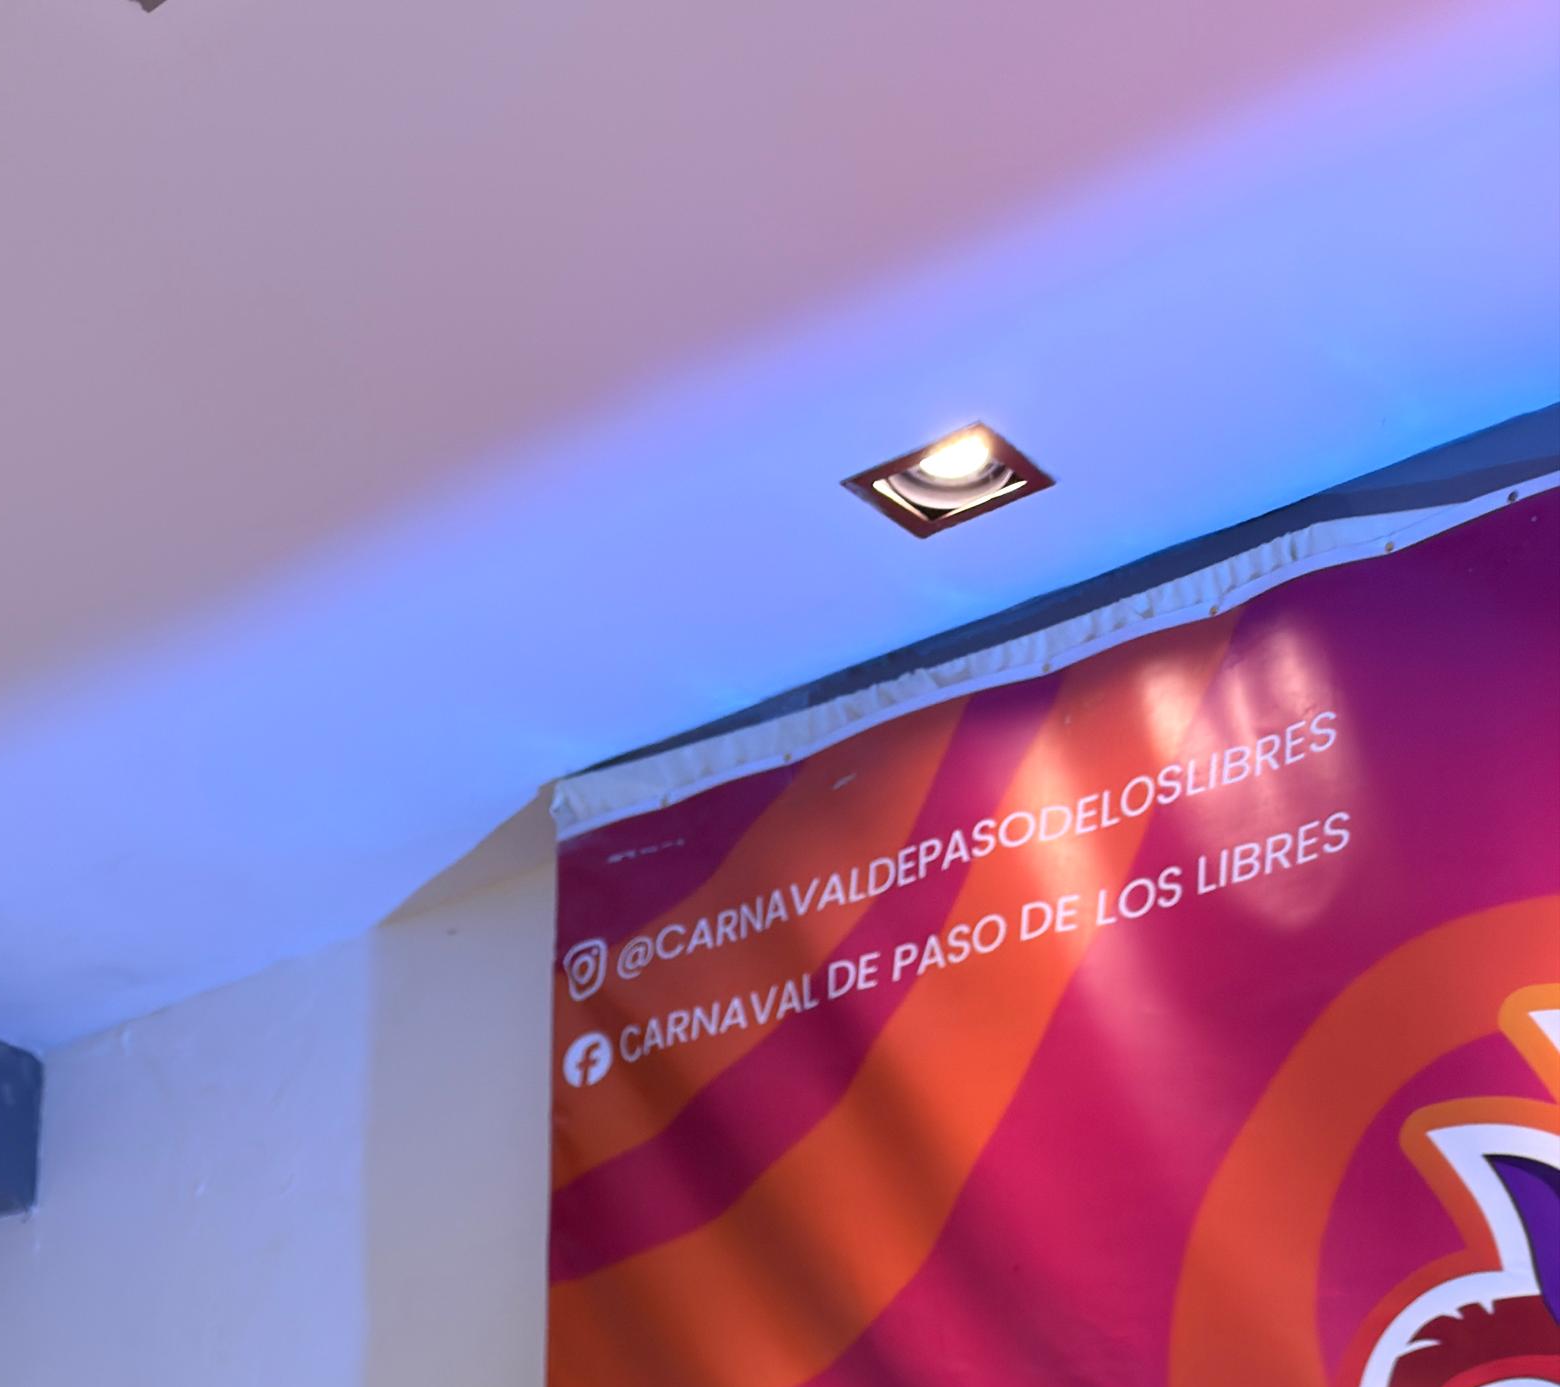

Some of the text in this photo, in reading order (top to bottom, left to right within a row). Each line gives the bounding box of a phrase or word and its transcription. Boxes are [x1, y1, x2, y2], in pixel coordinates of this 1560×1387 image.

[617, 710, 1337, 980] @CARNAVALDEPASODELOSLIBRES
[619, 811, 1351, 1063] CARNAVAL DE PASO DE LOS LIBRES
